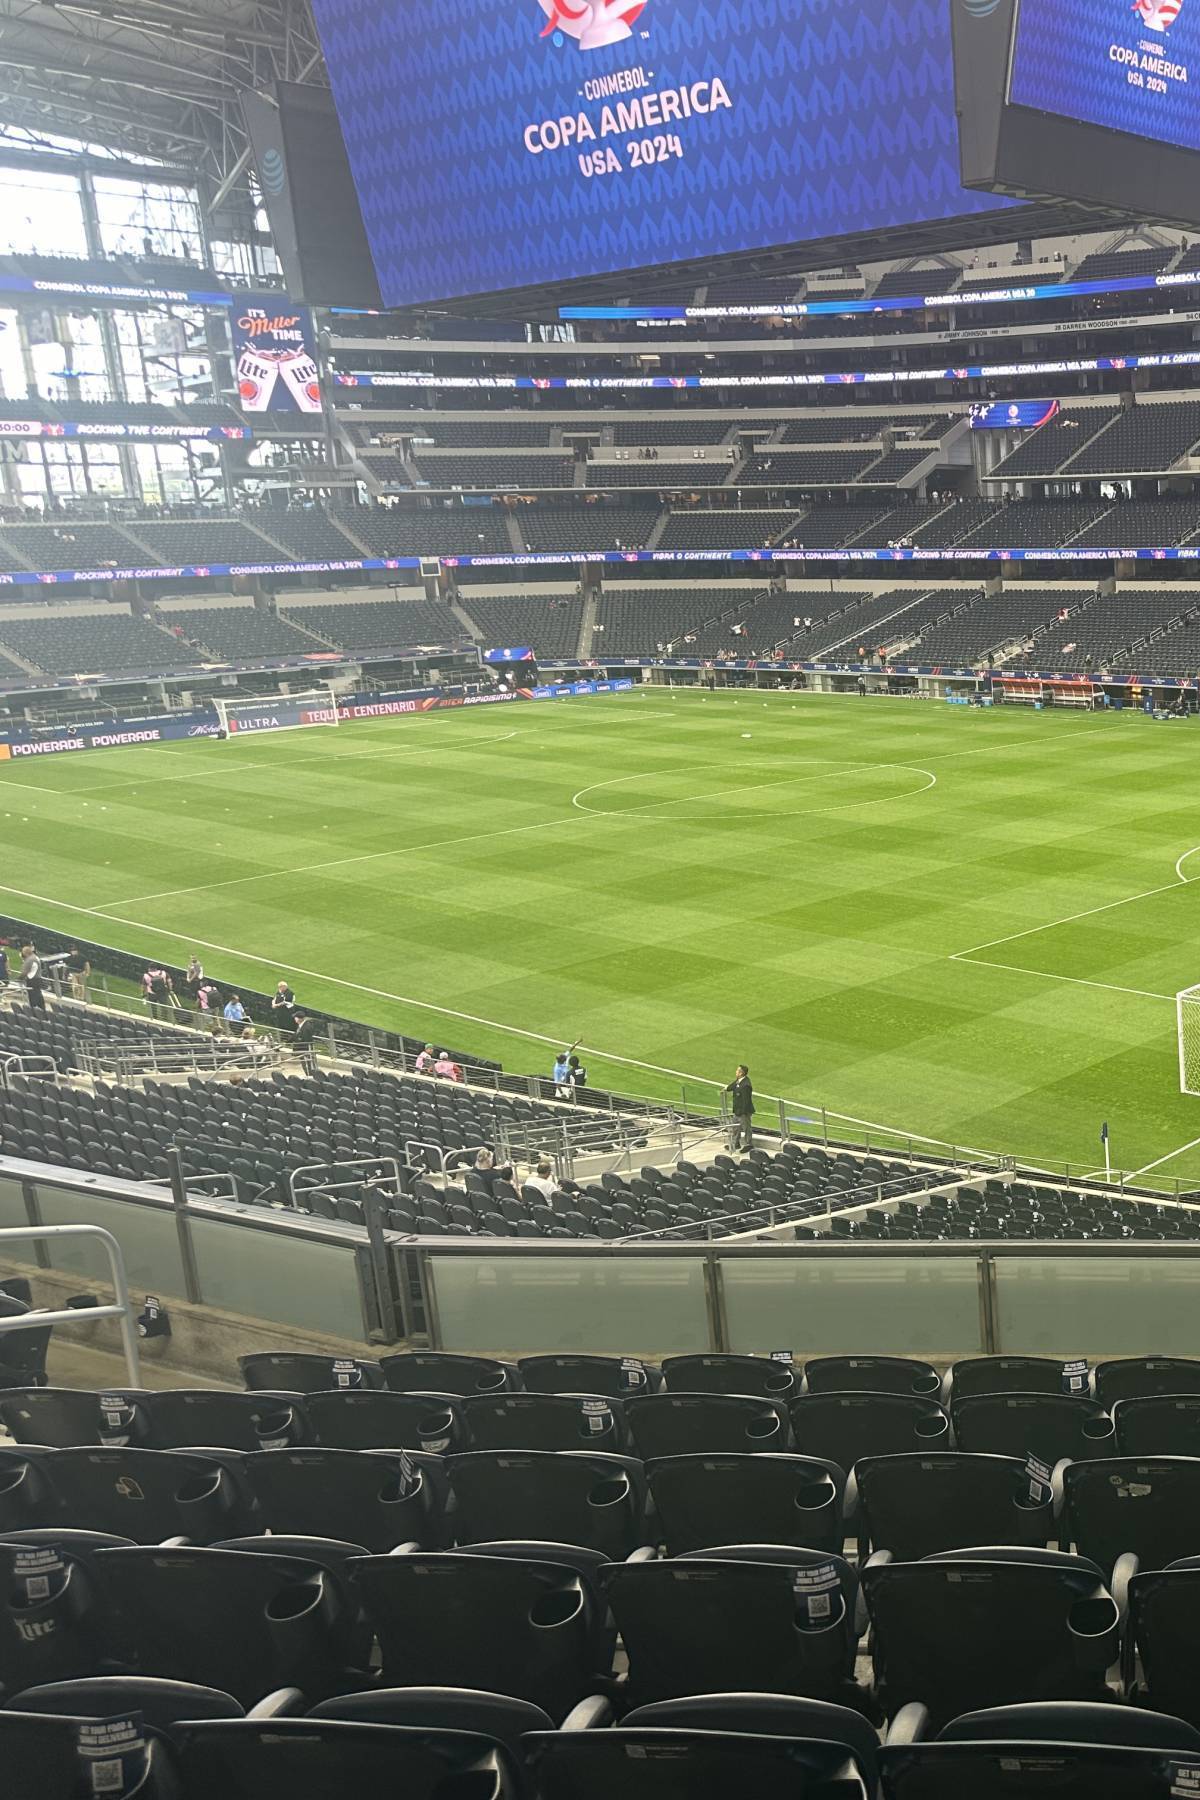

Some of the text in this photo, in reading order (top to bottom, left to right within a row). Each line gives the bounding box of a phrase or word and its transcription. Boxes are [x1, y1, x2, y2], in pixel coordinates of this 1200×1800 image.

[1109, 44, 1187, 82] COPA AMERICA
[584, 66, 649, 101] CONMEBOL
[1127, 70, 1167, 93] USA 2024
[524, 77, 732, 154] COPA AMERICA
[579, 133, 683, 177] USA 2024
[247, 308, 265, 318] IT'S
[238, 316, 300, 337] Miller
[271, 329, 304, 341] TIME
[239, 358, 317, 383] Lite Lite
[1177, 549, 1199, 557] VIBRA
[307, 700, 416, 723] TEQUILA CENTENARIO
[238, 717, 279, 731] ULTRA
[12, 730, 161, 756] POWERADE POWERADE
